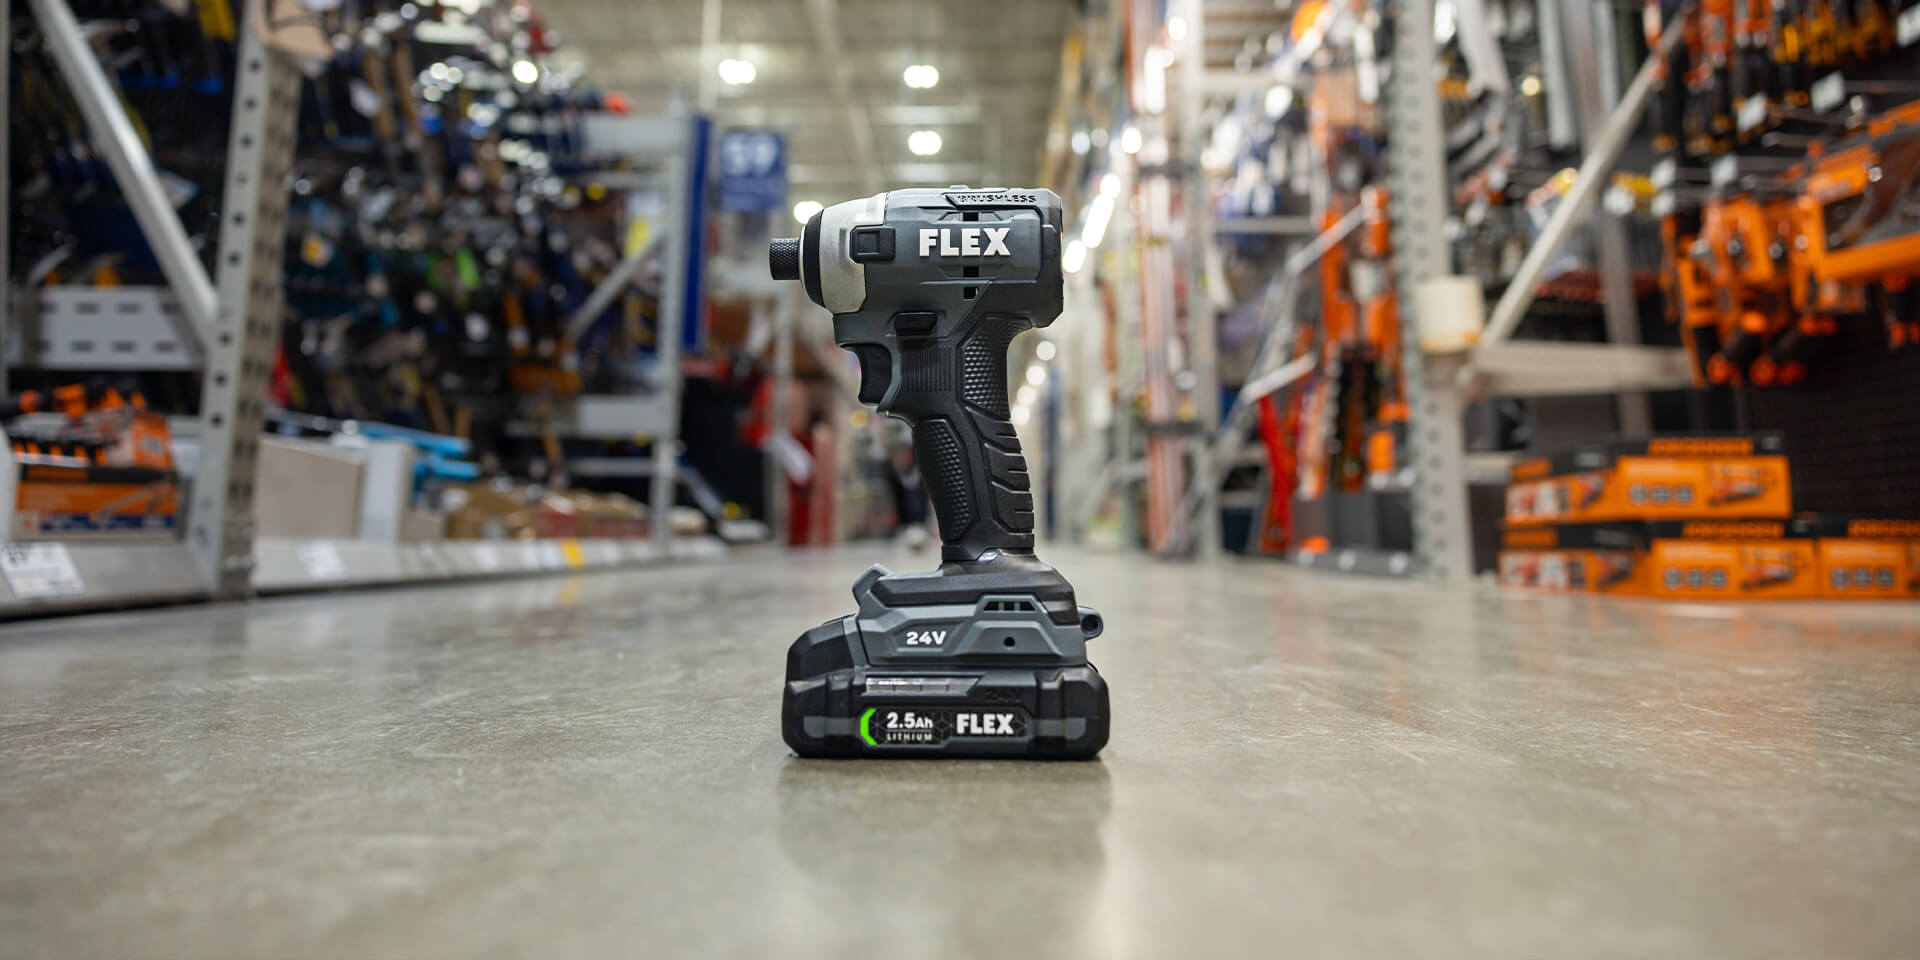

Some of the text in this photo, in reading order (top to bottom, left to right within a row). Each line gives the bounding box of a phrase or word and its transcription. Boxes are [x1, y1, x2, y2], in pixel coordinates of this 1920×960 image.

[957, 194, 1037, 203] BRUSHLESS
[919, 228, 1011, 257] FLEX
[906, 631, 947, 645] 24V
[886, 712, 1014, 734] 2.5Ah FLEX
[886, 732, 933, 741] LITHIUM
